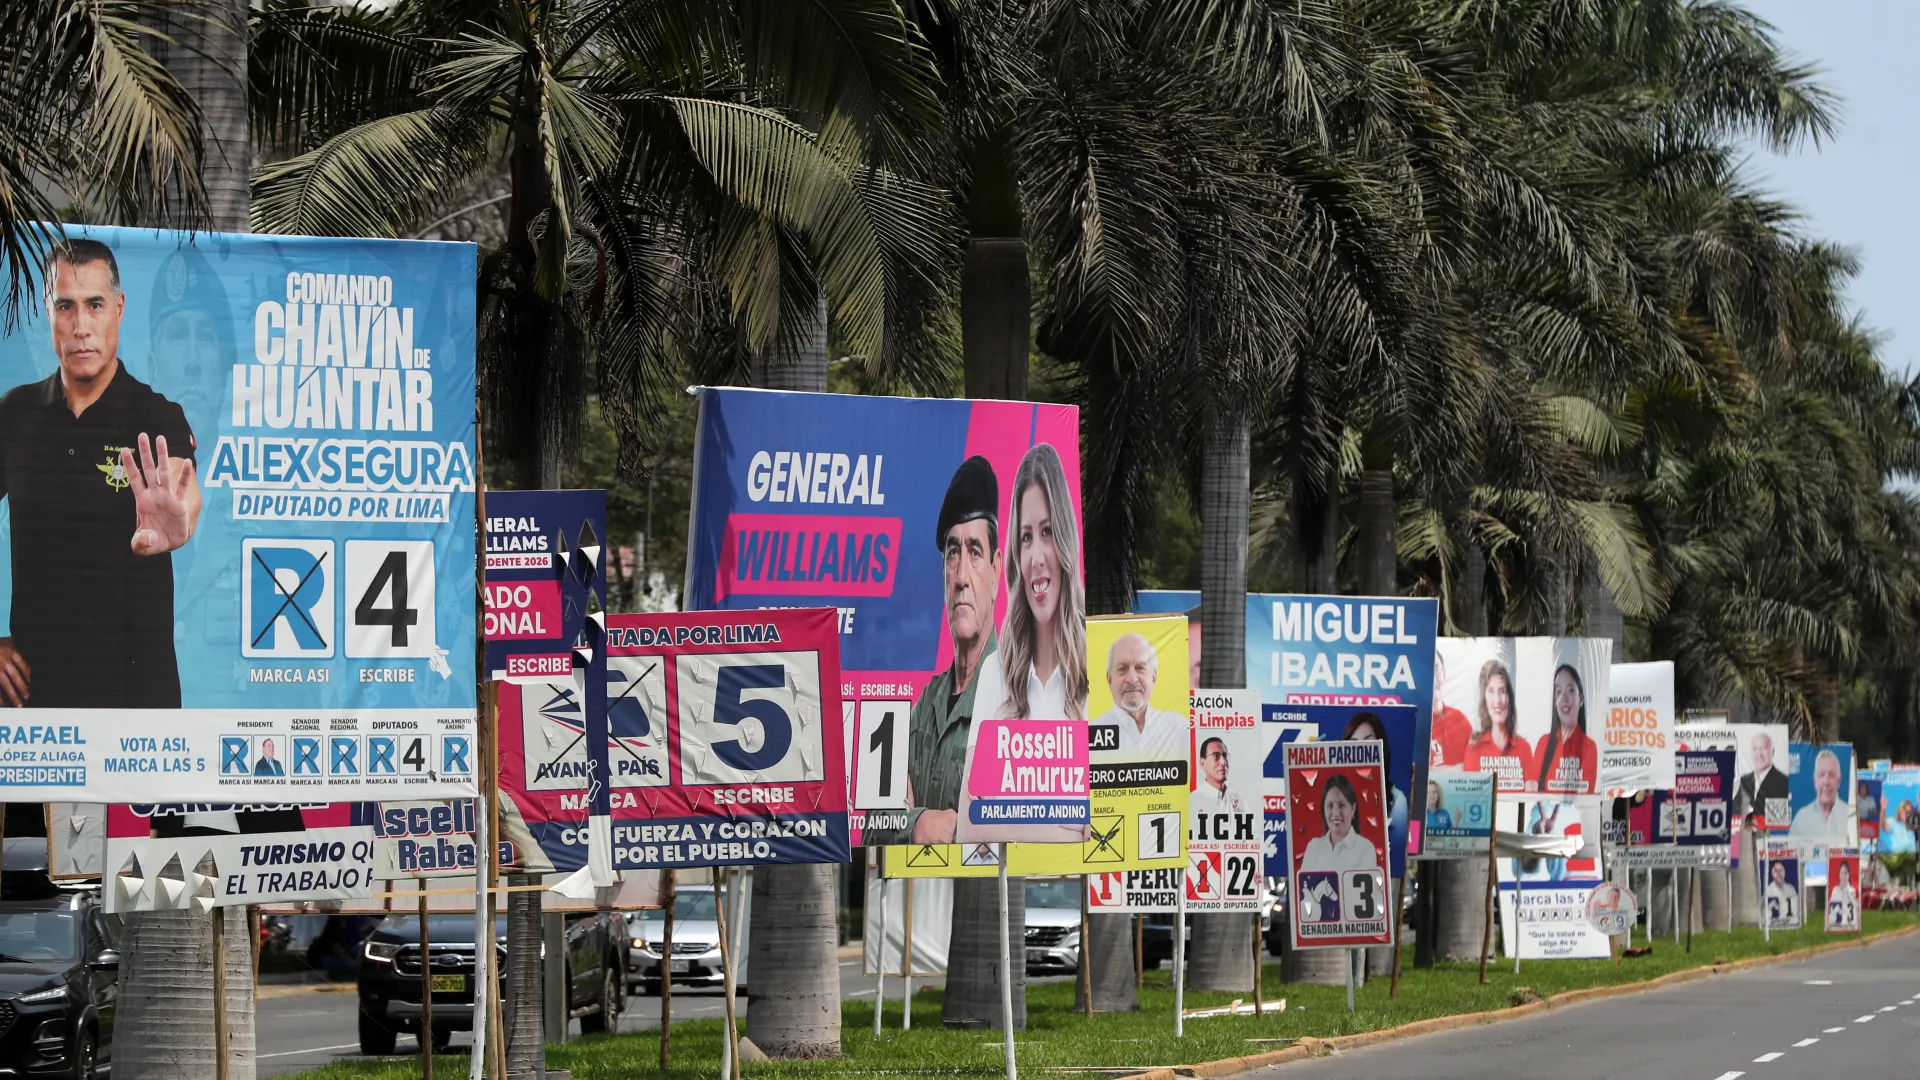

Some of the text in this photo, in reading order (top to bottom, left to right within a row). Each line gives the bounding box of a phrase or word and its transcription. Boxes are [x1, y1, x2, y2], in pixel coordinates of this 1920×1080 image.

[287, 271, 393, 307] COMANDO
[254, 300, 431, 370] CHAVÍN DE
[232, 363, 434, 432] HUÁNTAR
[208, 440, 473, 490] ALEX SEGURA
[746, 449, 886, 506] GENERAL
[237, 494, 445, 519] DIPUTADO POR LIMA
[524, 556, 549, 567] 2026
[736, 529, 891, 584] WILLIAMS
[354, 550, 419, 648] 4
[1272, 601, 1418, 645] MIGUEL
[675, 623, 781, 646] POR LIMA
[508, 657, 570, 674] ESCRIBE
[1270, 650, 1416, 691] IBARRA
[250, 668, 330, 684] MARCA ASI
[359, 668, 416, 684] ESCRIBE
[860, 681, 914, 697] ESCRIBE ASÍ:
[1624, 695, 1639, 704] CON
[1640, 695, 1652, 703] LOS
[372, 721, 419, 730] DIPUTADOS
[710, 663, 793, 772] 5
[1199, 711, 1255, 731] Limpias
[1272, 712, 1308, 721] ESCRIBE
[0, 725, 87, 745] RAFAEL
[996, 724, 1074, 760] Rosselli
[1605, 730, 1667, 749] UESTOS
[1693, 729, 1738, 740] NACIONAL
[119, 737, 191, 754] VOTA ASI,
[402, 737, 426, 772] 4
[869, 711, 895, 797] 1
[1287, 744, 1381, 766] MARIA PARIONA
[40, 751, 86, 762] ALIAGA
[104, 757, 206, 773] MARCA LAS 5
[617, 755, 661, 776] PAÍS
[1602, 756, 1652, 768] CONGRESO
[0, 767, 85, 783] PRESIDENTE
[1000, 760, 1085, 793] Amuruz
[1117, 766, 1179, 783] CATERIANO
[1677, 776, 1711, 786] SENADO
[560, 792, 638, 811] MACA
[713, 786, 795, 805] ESCRIBE
[1093, 787, 1164, 799] SENADOR NACIONAL
[980, 803, 1086, 819] PARLAMENTO ANDINO
[1093, 807, 1115, 815] MARCA
[1147, 802, 1171, 812] ESCRIBE
[1469, 804, 1483, 823] 9
[867, 814, 908, 830] ANDINO
[1699, 808, 1724, 830] 10
[613, 823, 698, 844] FUERZA
[700, 823, 716, 840] Y
[718, 819, 828, 840] CORAZON
[1150, 816, 1165, 854] 1
[240, 840, 374, 867] TURISMO Q
[397, 837, 517, 872] Rabaa
[614, 841, 777, 864] POR EL PUEBLO.
[225, 874, 248, 896] EL
[256, 868, 360, 894] TRABAJO
[1197, 856, 1256, 896] 1 22
[1126, 891, 1177, 906] PRIMER
[1186, 901, 1221, 909] DIPUTADO
[1223, 901, 1258, 909] DIPUTADO
[1352, 873, 1375, 919] 3
[1555, 892, 1575, 905] las
[1578, 892, 1586, 905] 5
[1301, 922, 1386, 936] SENADORA NACIONAL
